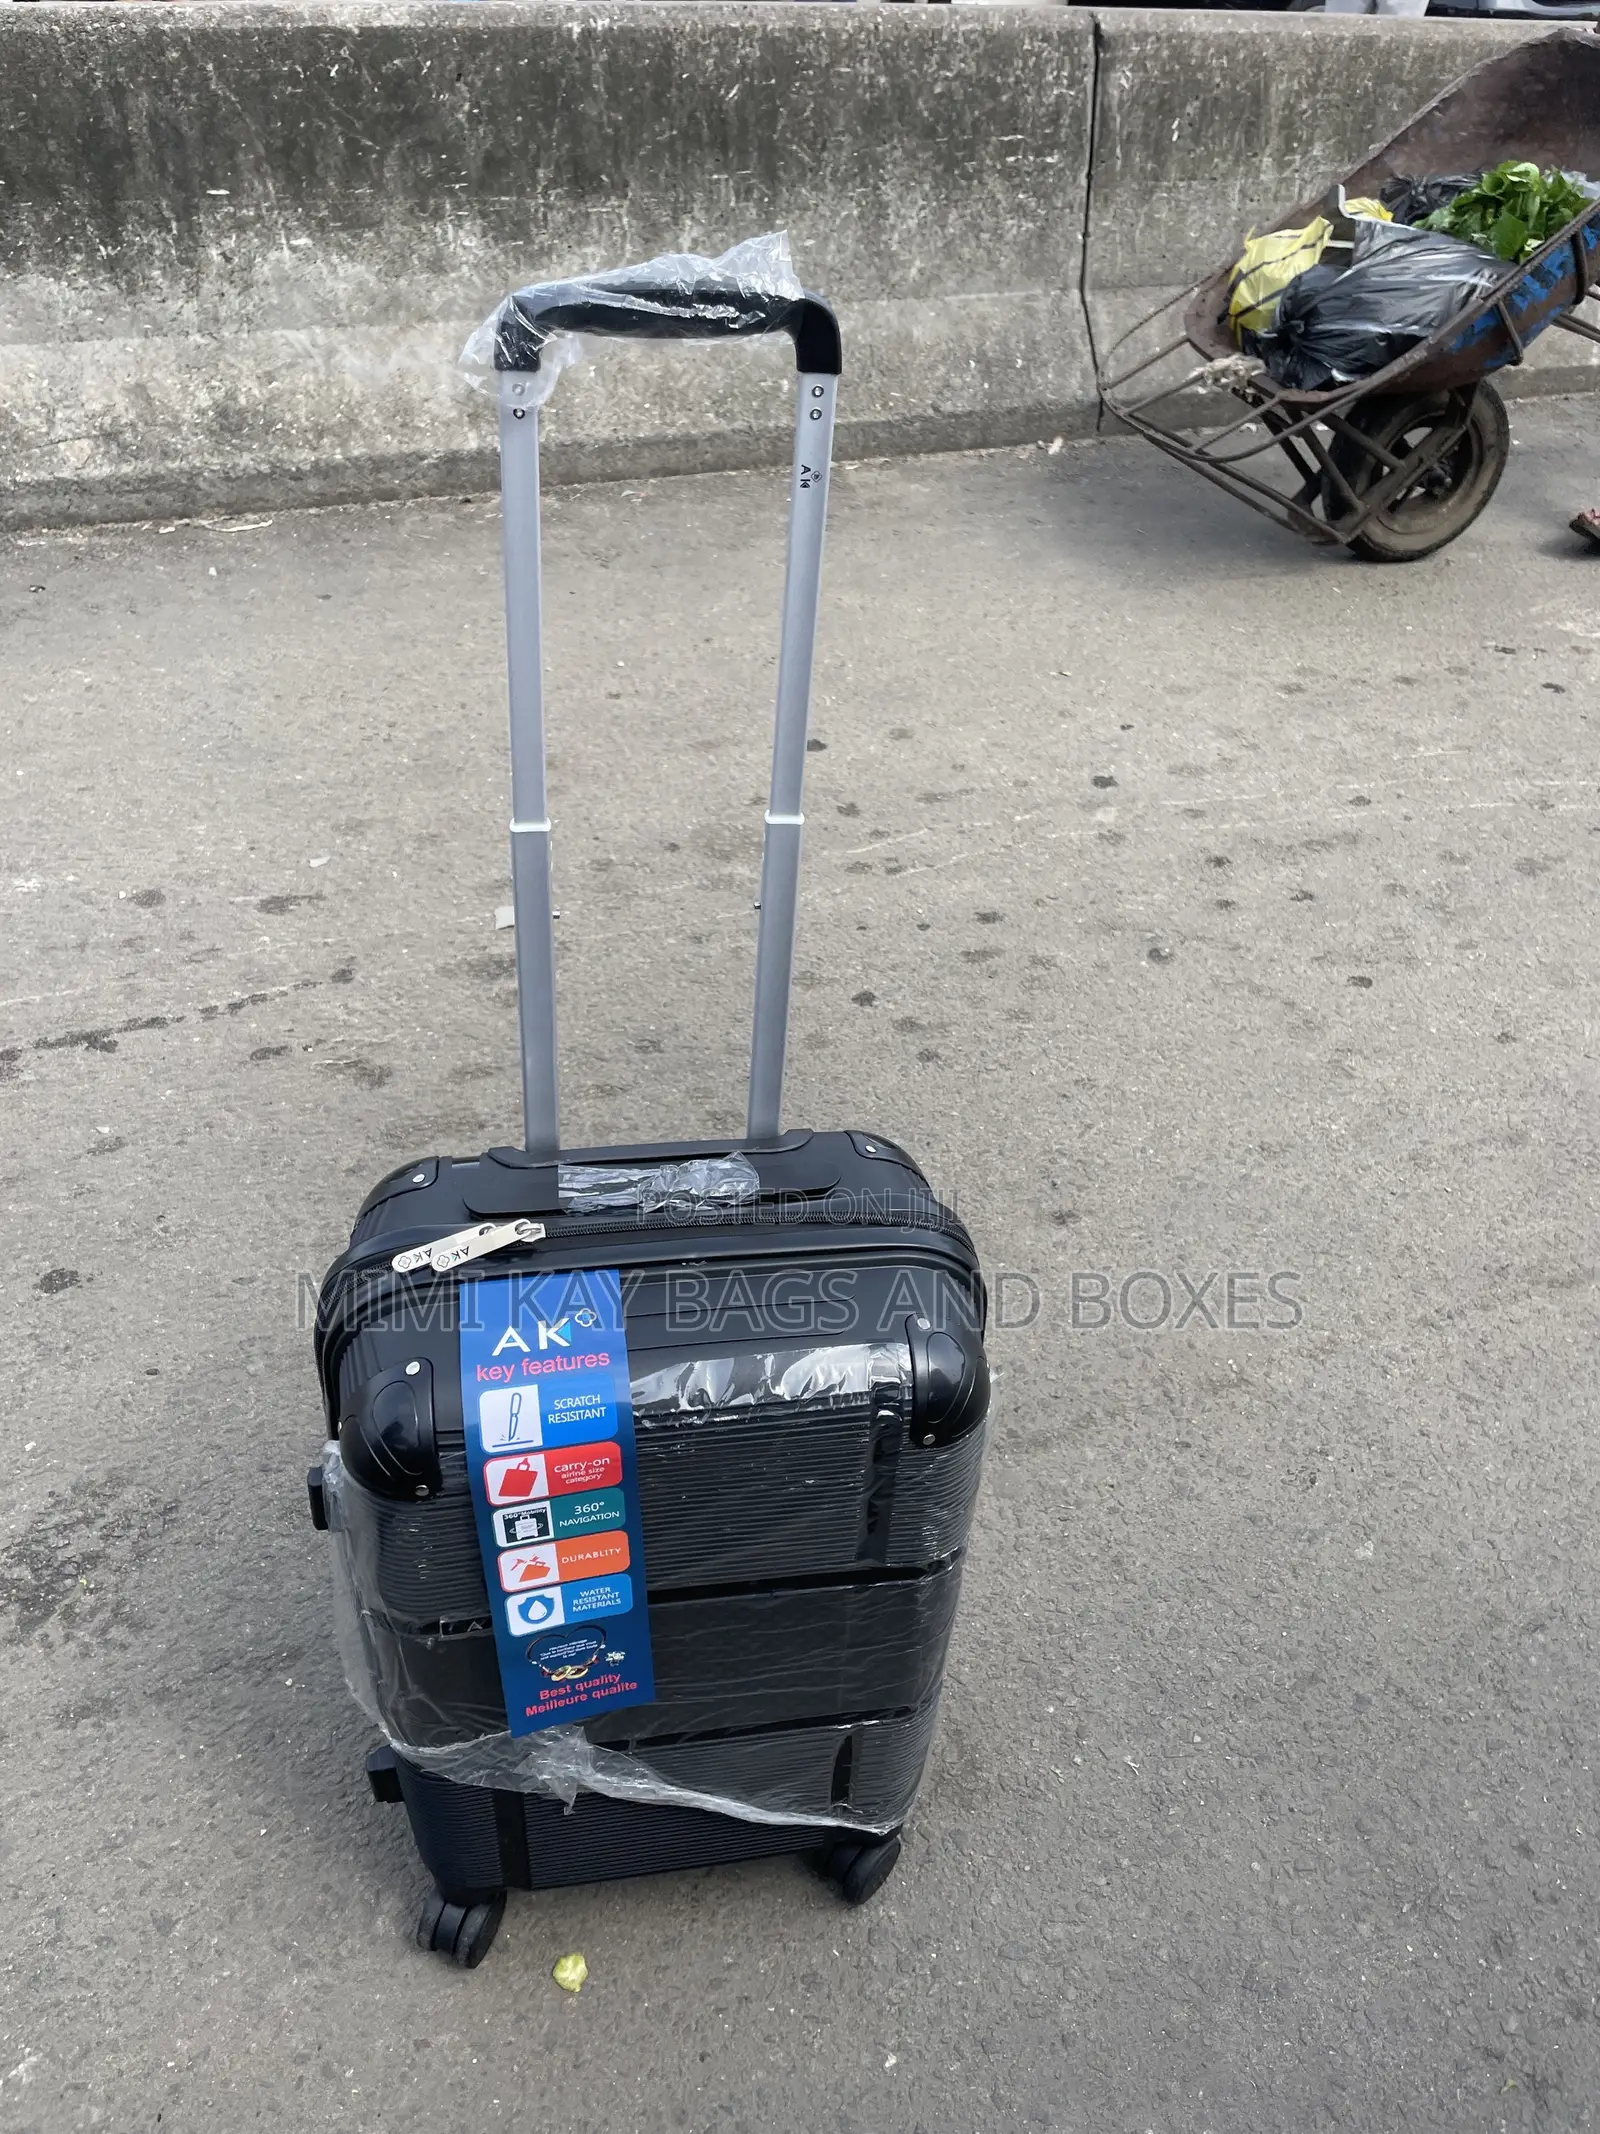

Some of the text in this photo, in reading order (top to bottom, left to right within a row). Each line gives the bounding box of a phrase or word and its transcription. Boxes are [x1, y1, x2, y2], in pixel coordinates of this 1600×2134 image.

[491, 1317, 571, 1356] AK
[476, 1352, 610, 1383] key features
[554, 1394, 601, 1410] SCRATCH
[548, 1406, 607, 1424] RESISITANT
[554, 1457, 610, 1474] carry-on
[565, 1473, 603, 1484] category
[574, 1501, 605, 1515] 360°
[559, 1511, 620, 1527] NAVIGATION
[561, 1547, 622, 1564] DURABLITY
[572, 1592, 620, 1606] RESISTANT
[579, 1586, 611, 1597] WATER
[572, 1598, 622, 1612] MATERIALS
[539, 1673, 621, 1700] Best quality
[525, 1681, 638, 1717] Meilleure qualite
